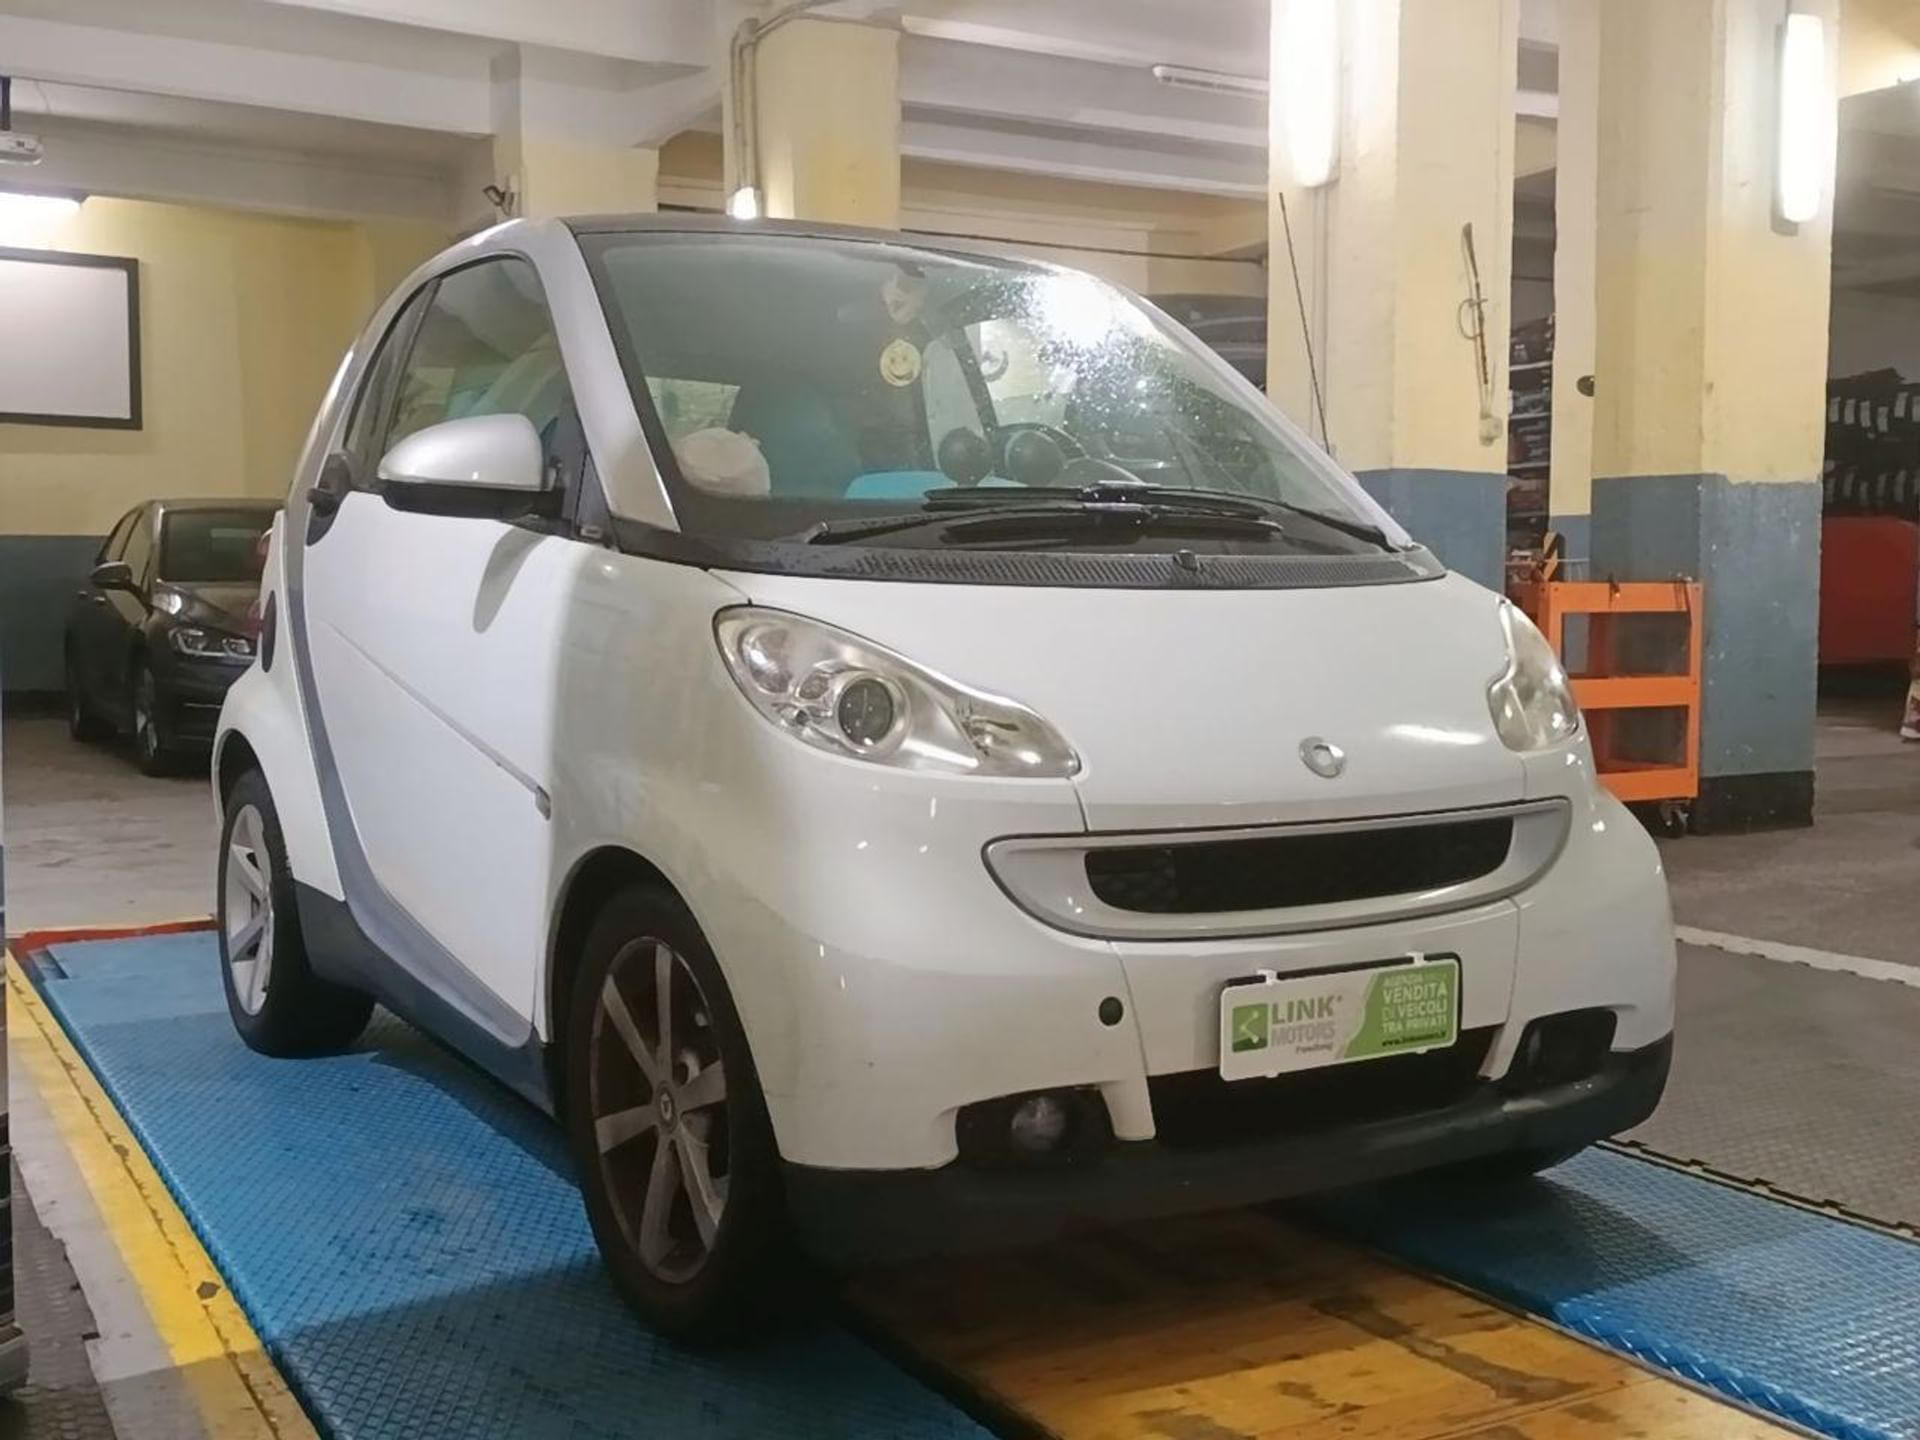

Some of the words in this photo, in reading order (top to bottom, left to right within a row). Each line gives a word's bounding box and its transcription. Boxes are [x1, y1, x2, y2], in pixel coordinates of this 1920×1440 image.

[1383, 981, 1447, 1004] VENDITA
[1272, 995, 1334, 1024] LINK
[1397, 999, 1447, 1018] VEICOLI
